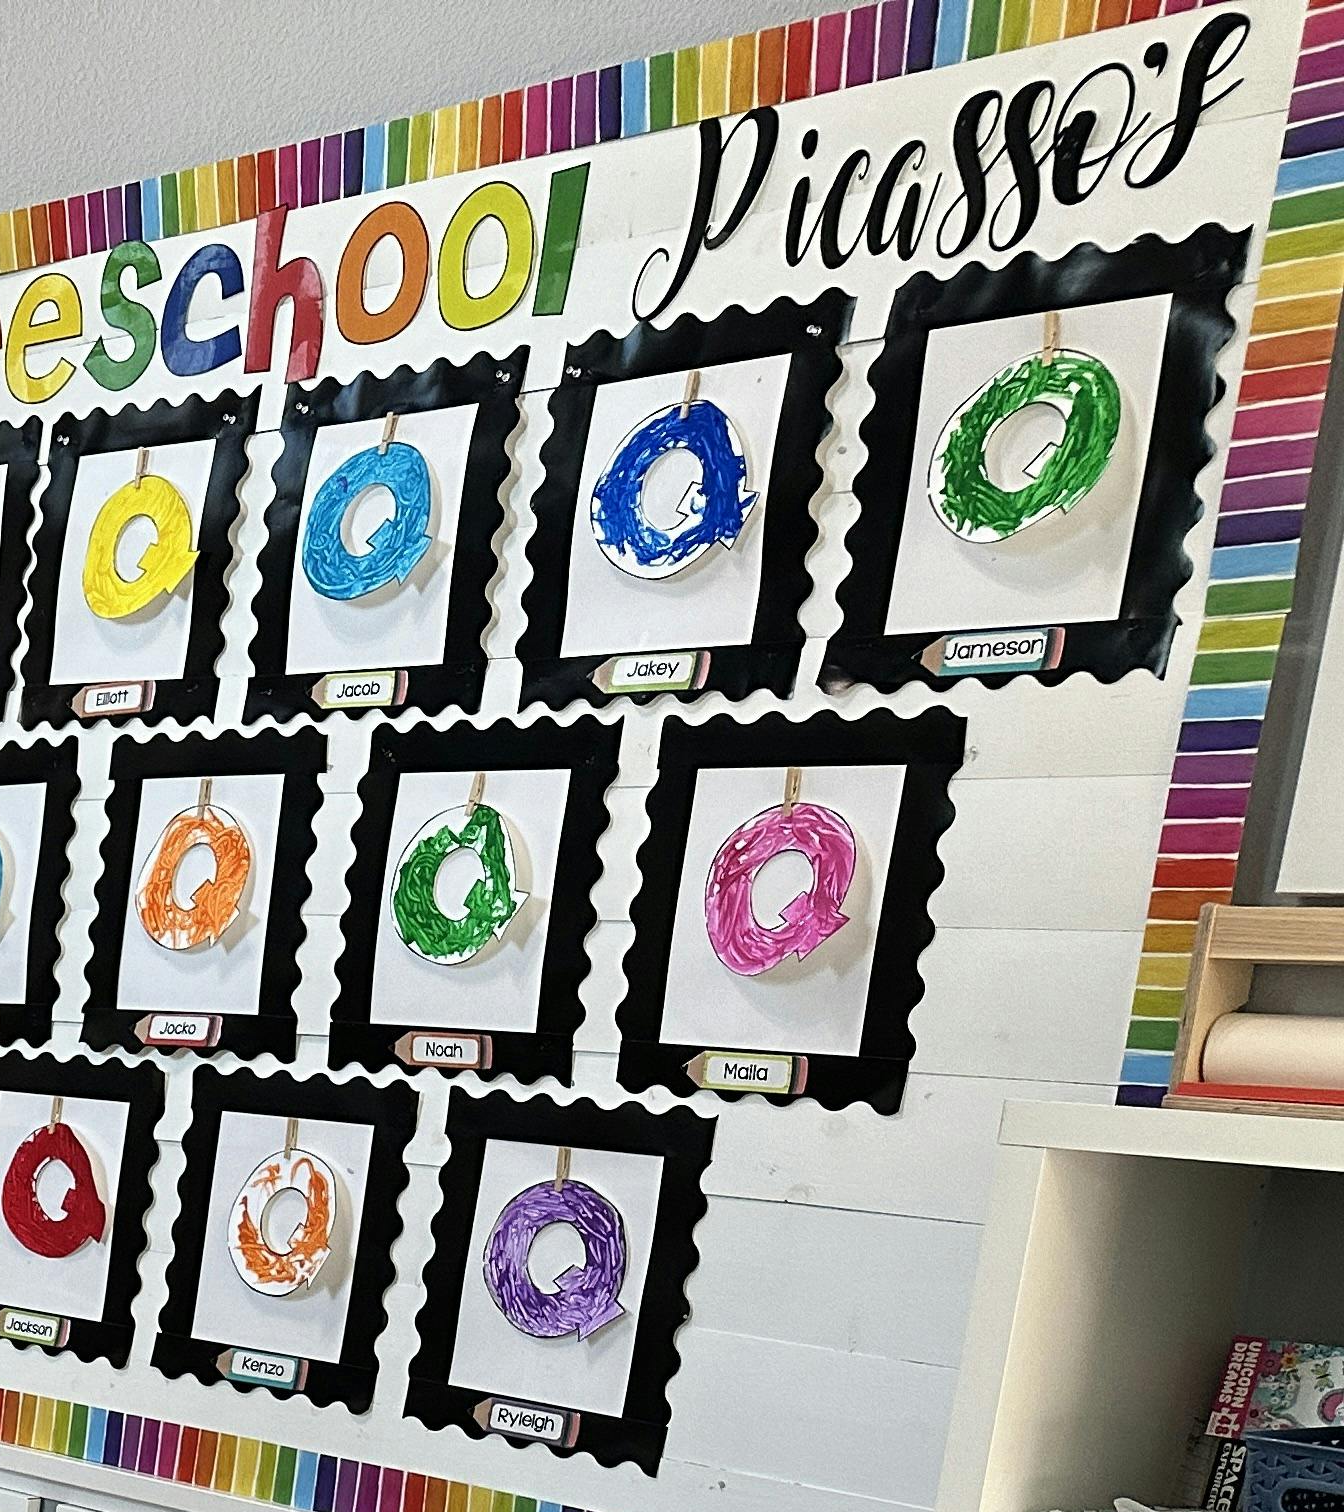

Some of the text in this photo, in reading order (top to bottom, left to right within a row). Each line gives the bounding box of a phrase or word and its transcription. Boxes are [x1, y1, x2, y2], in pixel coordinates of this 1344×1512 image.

[631, 12, 1251, 321] Picasso's
[945, 637, 1044, 661] Jameson
[627, 661, 679, 678] Jakey
[336, 681, 380, 699] Jacob
[159, 1021, 196, 1035] Jocko
[425, 1041, 462, 1058] Noah
[6, 1317, 53, 1337] Jackson
[241, 1357, 284, 1376] Kenzo
[1218, 1342, 1247, 1404] DREAMS
[1230, 1341, 1263, 1408] UNICORN
[498, 1407, 555, 1432] Ryleigh
[1216, 1444, 1247, 1512] SPACE
